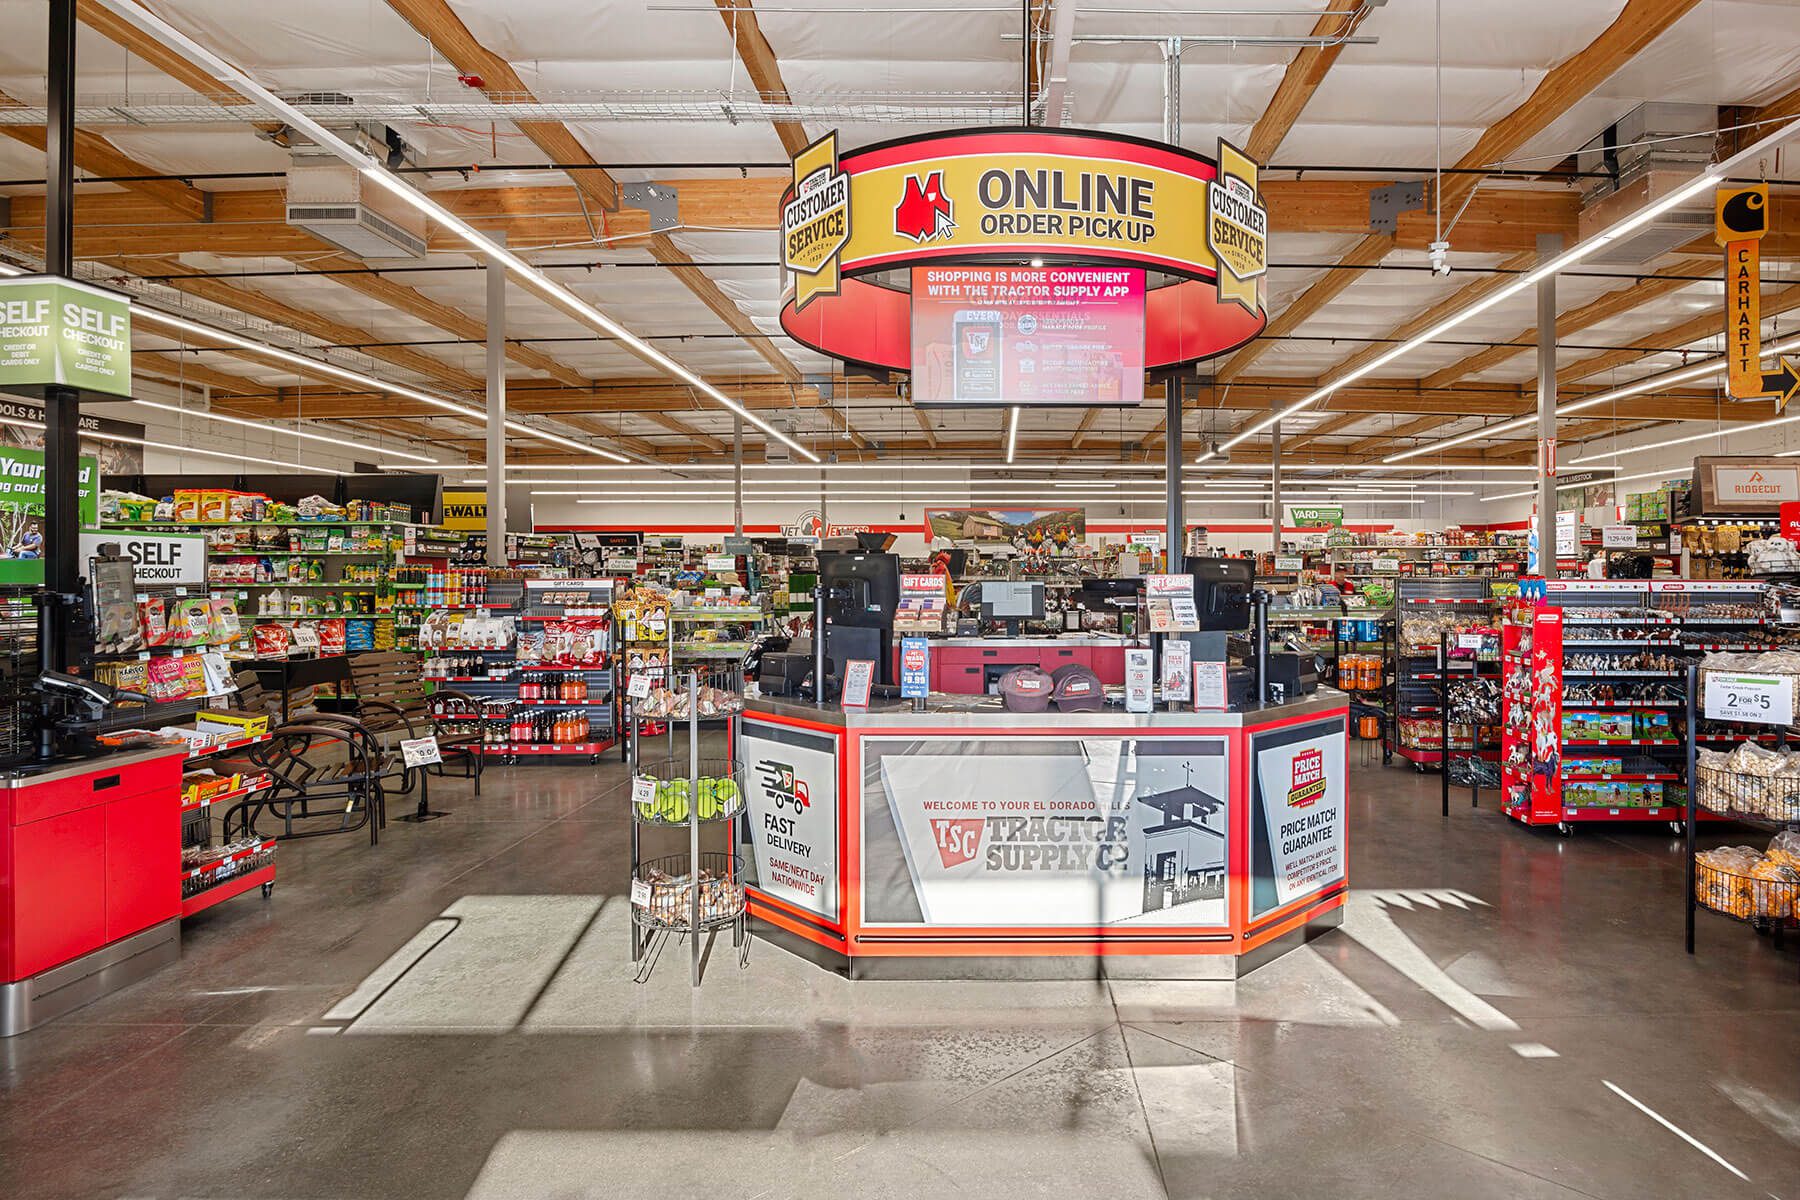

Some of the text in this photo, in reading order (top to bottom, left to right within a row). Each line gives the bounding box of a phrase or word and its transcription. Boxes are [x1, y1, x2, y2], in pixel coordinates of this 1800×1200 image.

[786, 179, 845, 229] CUSTOMER
[978, 169, 1154, 220] ONLINE
[1212, 187, 1265, 235] CUSTOMER
[789, 209, 844, 260] SERVICE
[980, 213, 1063, 235] ORDER
[1214, 217, 1263, 266] SERVICE
[927, 271, 1130, 283] SHOPPING IS MORE CONVENIENT
[928, 285, 1129, 297] WITH THE TRACTOR SUPPLY APP
[63, 303, 125, 337] SELF
[1738, 249, 1750, 372] CARHARTT
[0, 325, 50, 338] HECKOUT
[63, 328, 125, 351] CHECKOUT
[0, 404, 26, 418] OLS
[28, 408, 36, 420] &
[0, 457, 45, 478] Your
[14, 483, 38, 493] and
[1735, 485, 1781, 494] RIDGECUT
[1293, 510, 1318, 518] YARD
[781, 527, 800, 536] VET
[127, 541, 182, 565] SELF
[133, 567, 182, 579] HECKOUT
[903, 577, 944, 587] GIFT CARDS
[1727, 693, 1737, 707] 2
[1754, 694, 1770, 709] $5
[1294, 756, 1320, 773] PRICE
[1293, 769, 1321, 786] MATCH
[923, 801, 978, 810] WELCOME
[982, 801, 996, 810] TO
[1000, 801, 1030, 810] YOUR
[1034, 801, 1046, 810] EL
[1050, 801, 1095, 810] DORADO
[764, 813, 796, 837] FAST
[986, 816, 1128, 842] TRACTOR
[1280, 807, 1336, 839] PRICE MATCH
[767, 833, 811, 858] DELIVERY
[935, 820, 975, 859] TSC
[1282, 825, 1333, 855] GUARANTEE
[986, 844, 1094, 871] SUPPLY
[1285, 845, 1337, 871] WE'LL MATCH ANY LOCAL
[1319, 856, 1332, 868] PRICE
[769, 857, 825, 886] SAME/NEXT DAY
[771, 871, 815, 896] NATIONWIDE
[1288, 864, 1338, 891] ON ANY IDENTICAL ITEM
